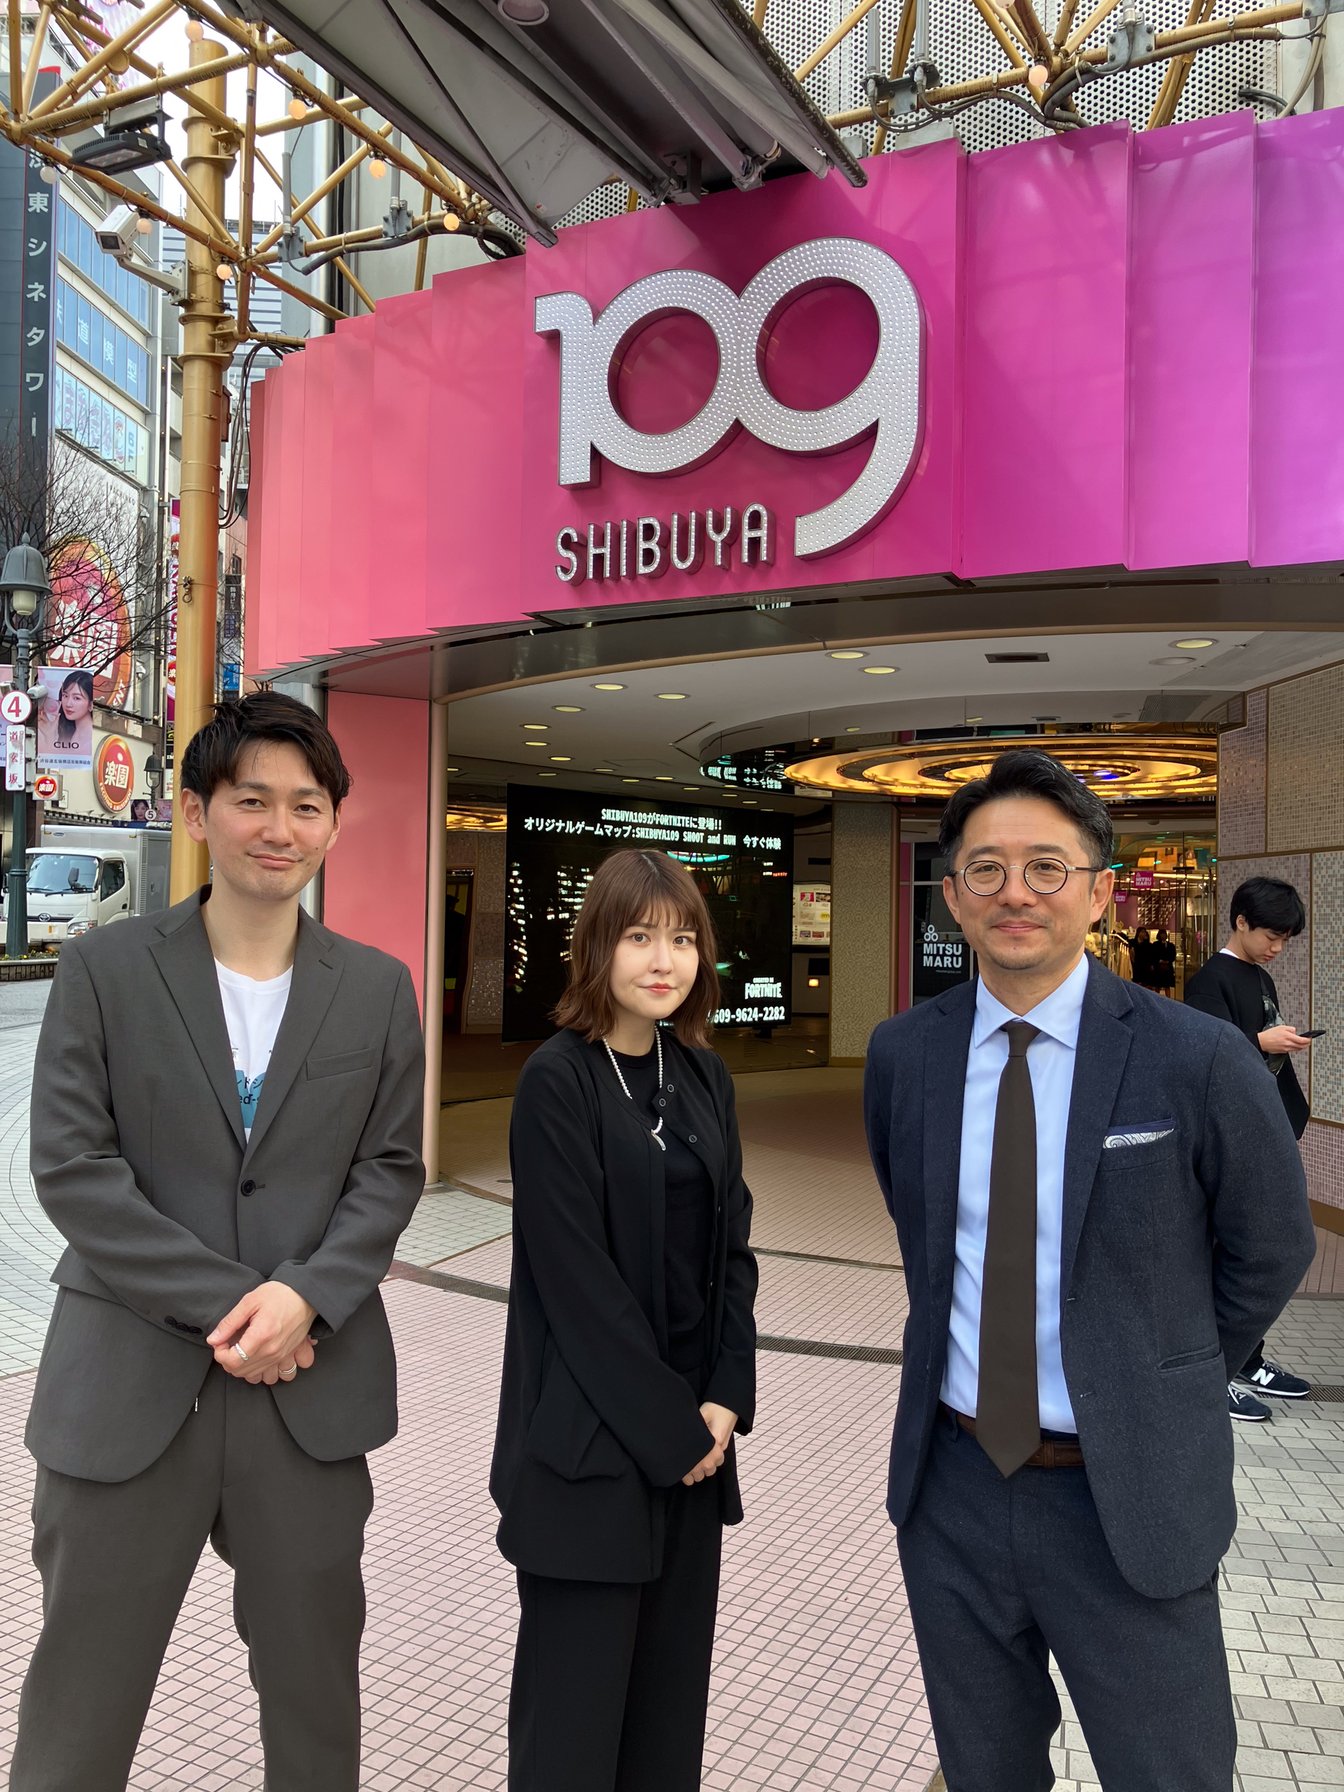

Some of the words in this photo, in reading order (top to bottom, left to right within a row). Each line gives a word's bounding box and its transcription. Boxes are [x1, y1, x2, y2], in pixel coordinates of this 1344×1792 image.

[534, 236, 923, 558] 109
[555, 503, 773, 583] SHIBUYA
[8, 696, 22, 718] 4
[53, 741, 80, 750] CLIO
[104, 760, 130, 789] 楽園
[147, 810, 154, 818] 5
[683, 831, 705, 843] SHOOT
[707, 833, 721, 845] and
[723, 834, 737, 846] RUN
[743, 834, 782, 850] 今すぐ体験
[923, 943, 962, 955] MITSU
[923, 955, 962, 968] MARU
[744, 982, 783, 1000] FORTNITE
[706, 1006, 785, 1023] 609-9624-2282
[1251, 1368, 1275, 1386] N
